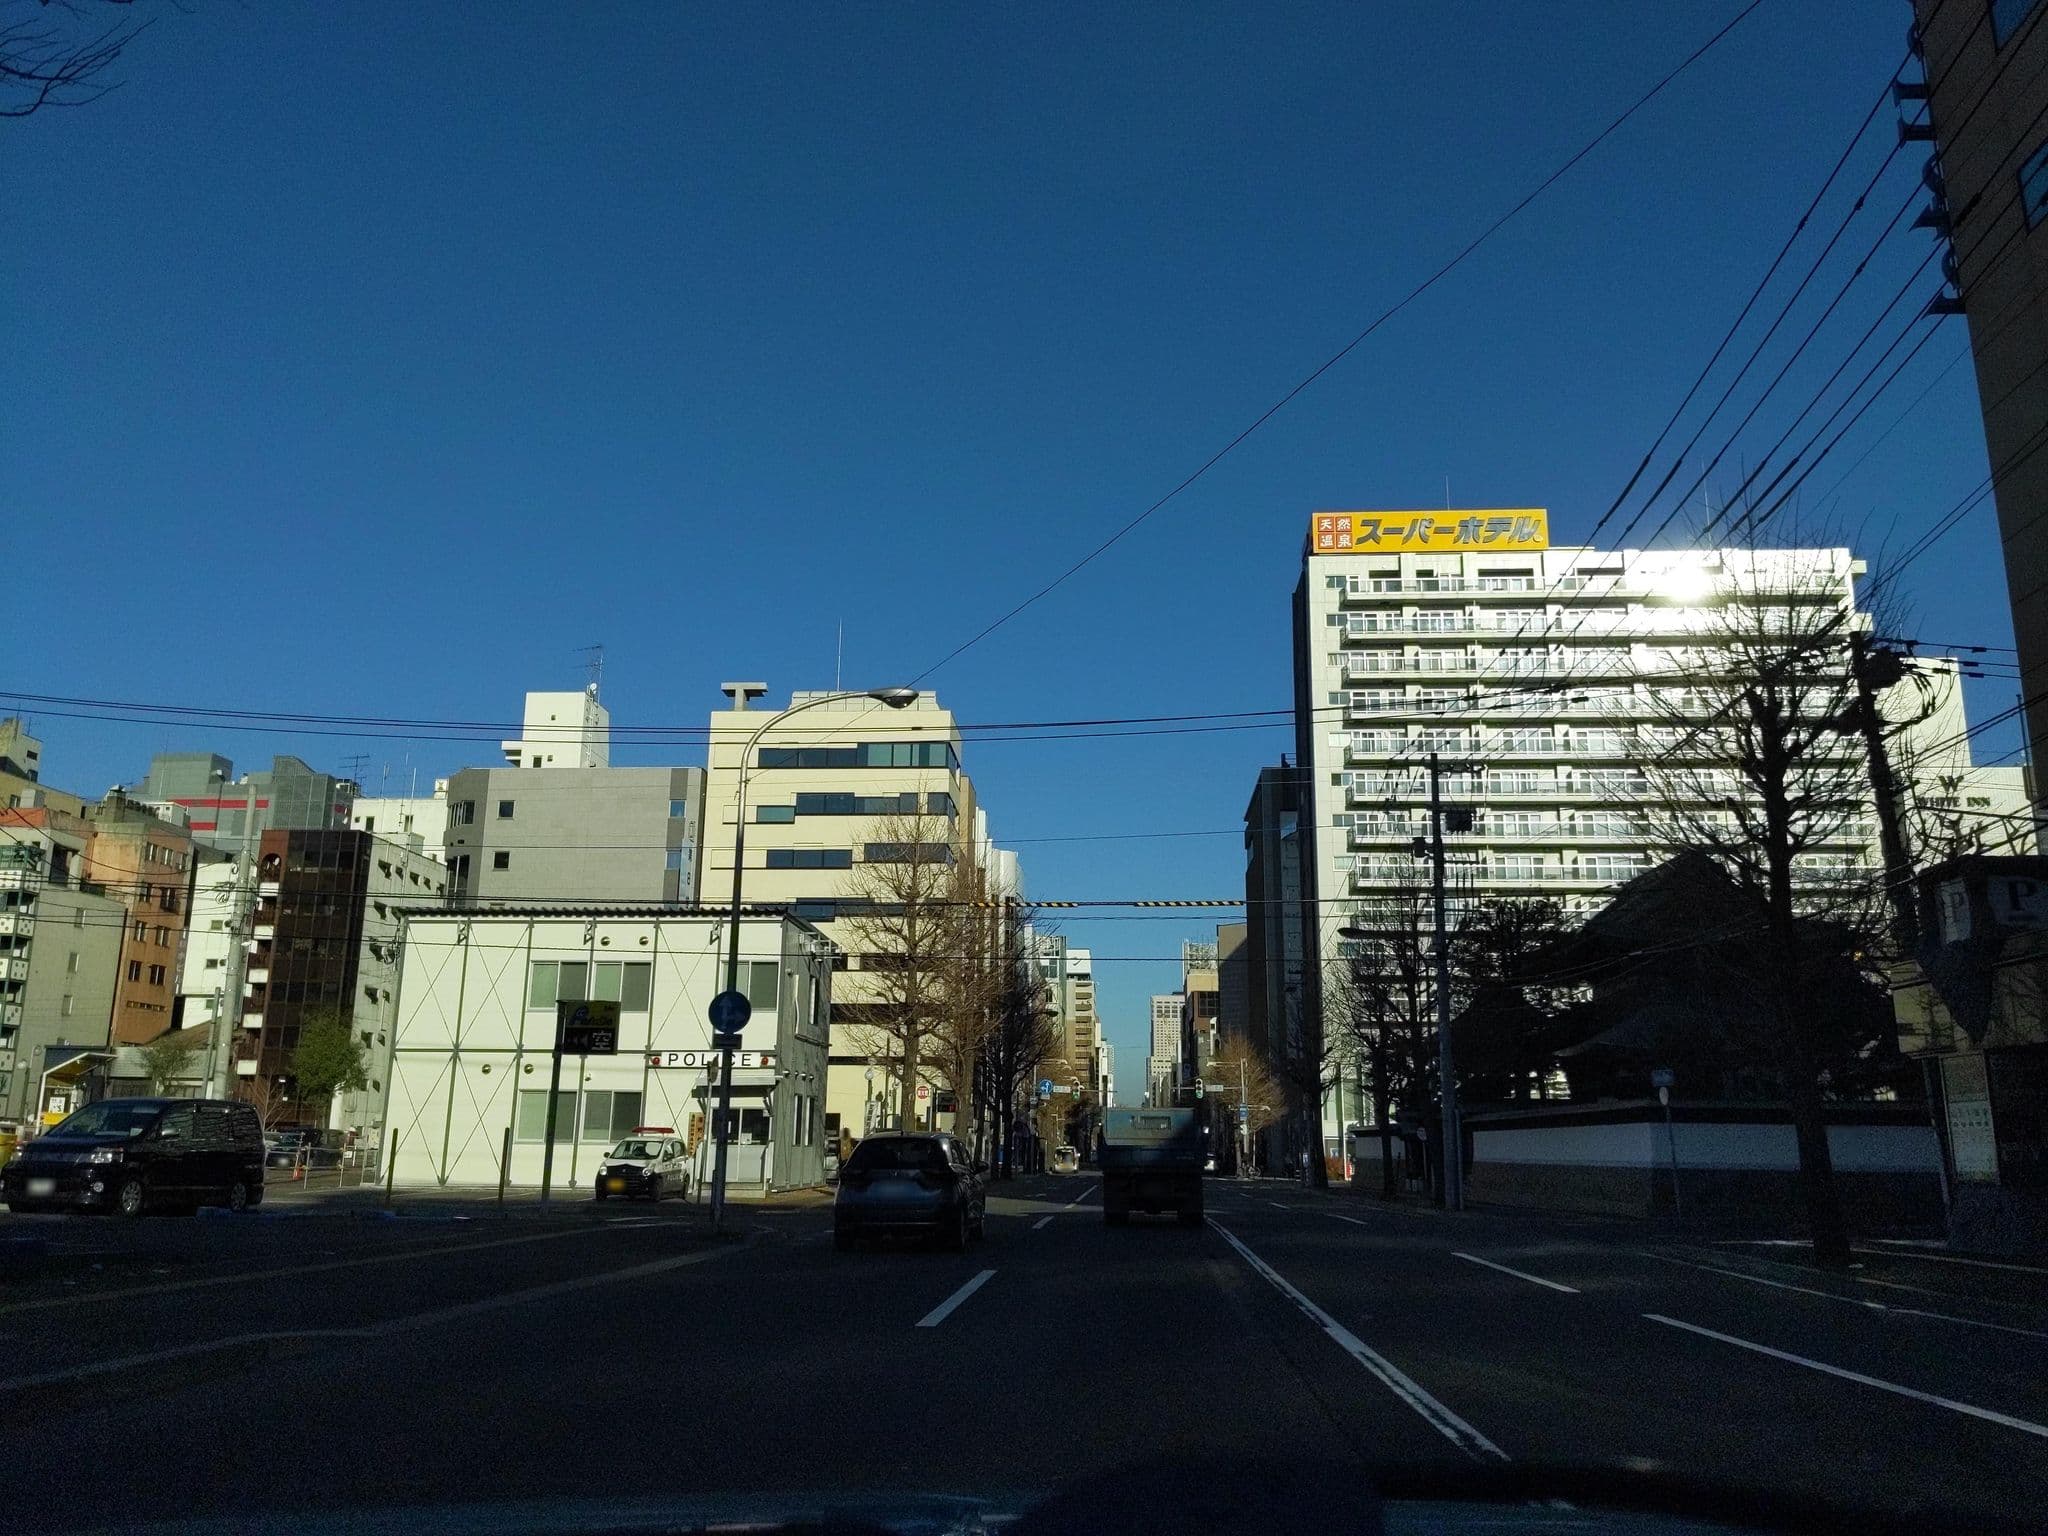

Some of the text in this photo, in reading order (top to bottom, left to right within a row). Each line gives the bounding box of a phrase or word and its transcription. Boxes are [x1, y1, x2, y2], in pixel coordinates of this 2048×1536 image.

[1319, 517, 1352, 531] 天然
[1355, 516, 1541, 545] スーパーホテル
[1320, 533, 1352, 548] 温泉
[1917, 796, 1991, 808] WHITE INN
[591, 1030, 613, 1051] 空
[668, 1053, 752, 1067] POLE
